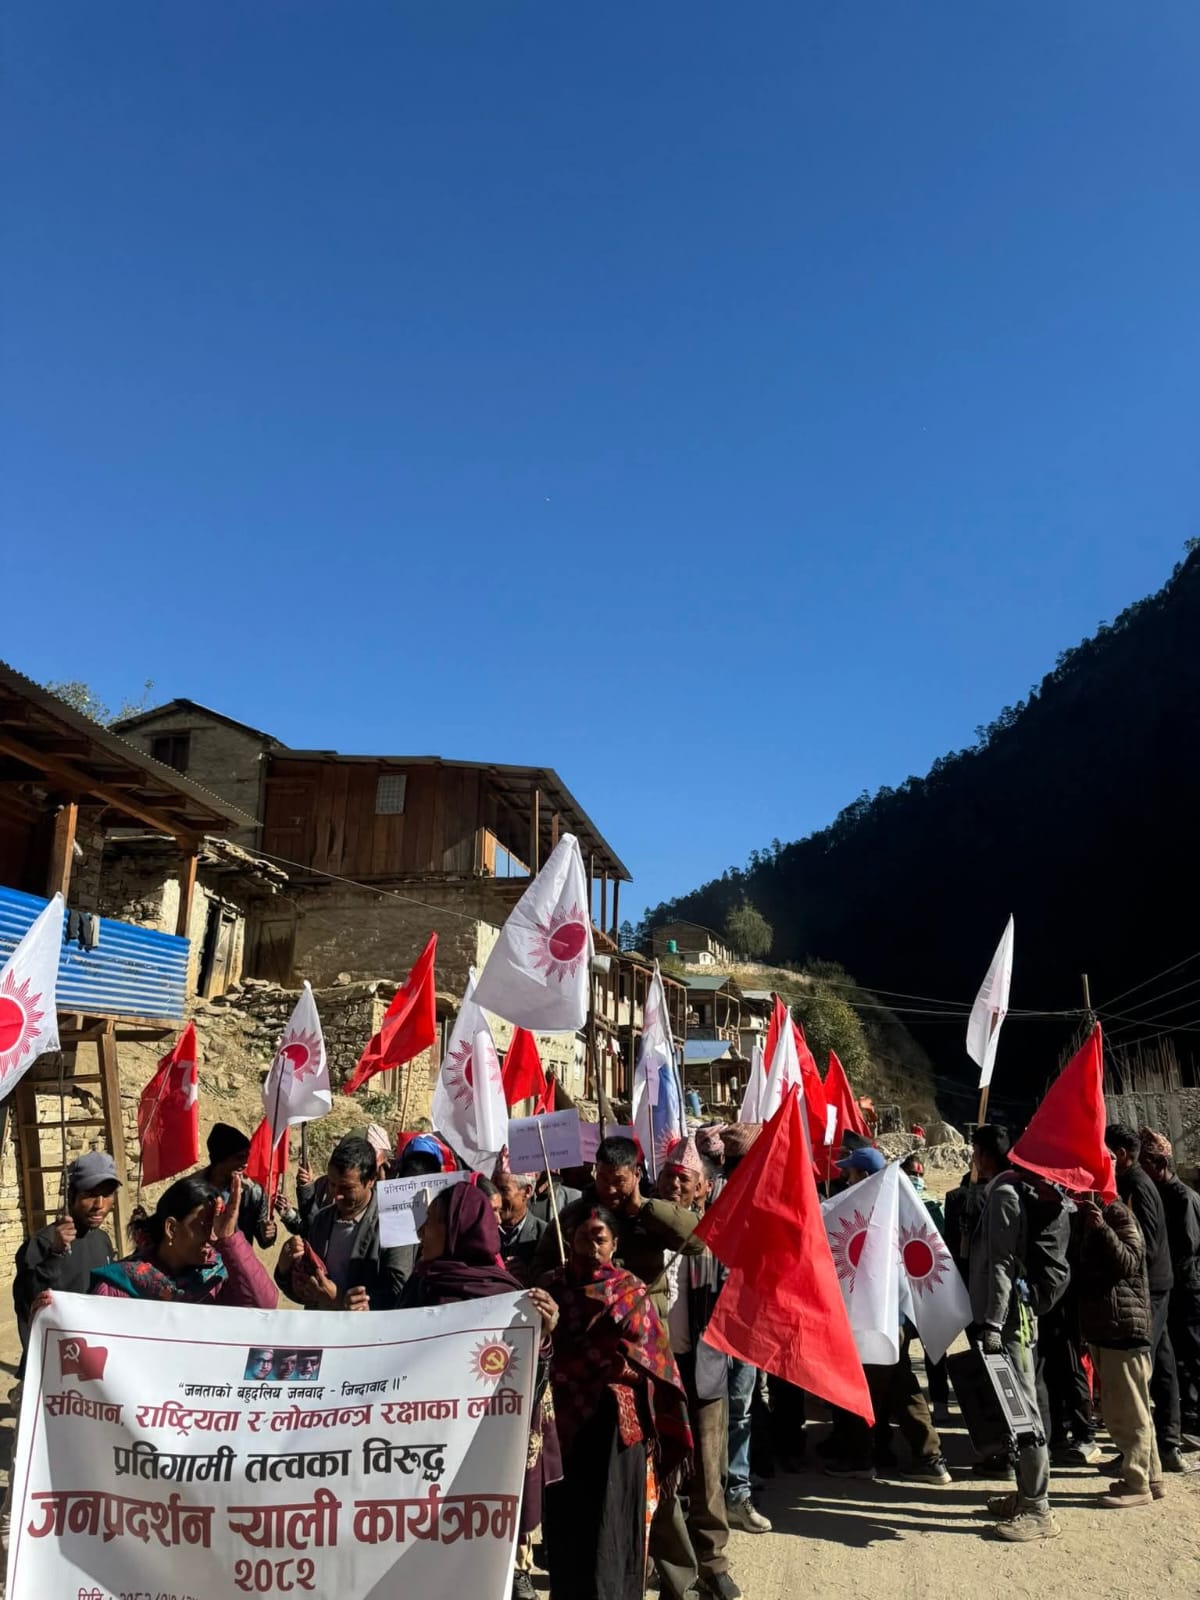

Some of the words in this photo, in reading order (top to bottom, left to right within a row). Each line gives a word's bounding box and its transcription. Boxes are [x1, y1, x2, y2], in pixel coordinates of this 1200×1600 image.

[135, 1400, 242, 1437] राष्ट्रियता
[269, 1403, 374, 1432] लोकतन्त्र
[381, 1398, 460, 1425] रक्षाका
[466, 1387, 524, 1419] लागि
[113, 1440, 238, 1483] प्रतिगामी
[245, 1449, 353, 1483] तत्वका
[27, 1490, 216, 1549] जनप्रदर्शन
[353, 1484, 520, 1546] कार्यक्रम
[233, 1558, 317, 1593] २०८२
